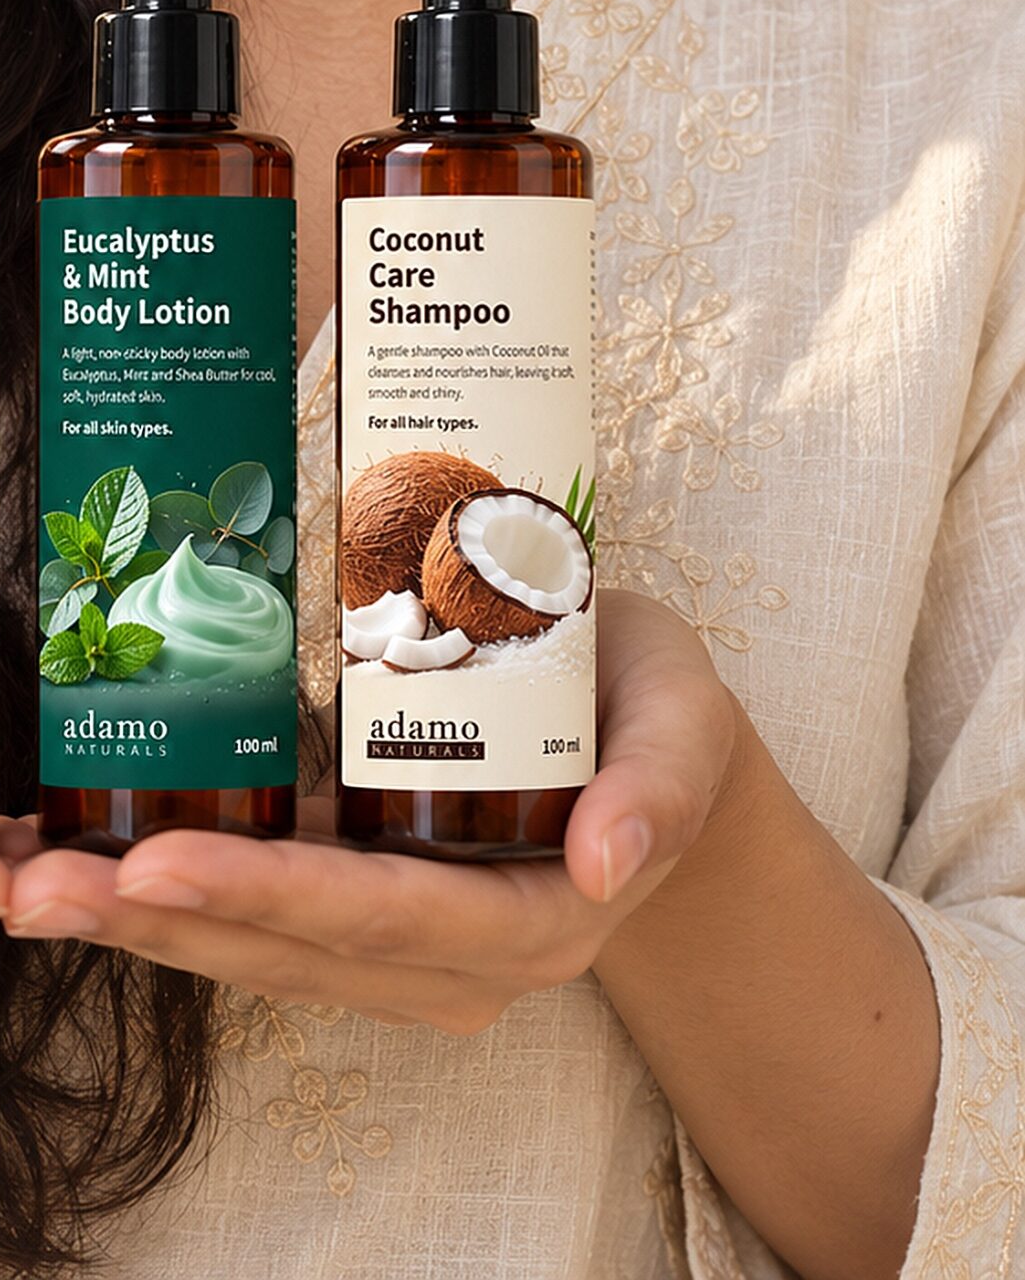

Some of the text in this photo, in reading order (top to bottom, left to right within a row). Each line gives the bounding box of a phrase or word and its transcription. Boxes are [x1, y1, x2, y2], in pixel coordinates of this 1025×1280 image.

[63, 227, 215, 260] Eucalyptus
[369, 227, 485, 252] Coconut
[63, 261, 150, 289] & Mint
[369, 262, 435, 288] Care
[63, 297, 230, 332] Body Lotion
[369, 296, 510, 330] Shampoo
[62, 347, 70, 359] A
[160, 346, 191, 363] body
[193, 346, 226, 359] lotion
[227, 346, 250, 359] with
[367, 346, 375, 357] A
[377, 345, 409, 360] gentle
[411, 345, 463, 359] shampoo
[465, 345, 490, 357] with
[492, 345, 536, 357] Coconut
[537, 344, 550, 357] Oil
[123, 368, 149, 381] Mint
[151, 368, 174, 381] and
[175, 367, 204, 381] Shea
[205, 367, 239, 381] Butter
[240, 367, 254, 380] for
[367, 365, 411, 378] cleanses
[413, 366, 433, 378] and
[435, 365, 488, 378] nourishes
[515, 366, 550, 381] leaving
[85, 390, 137, 407] hydrated
[368, 387, 407, 399] smooth
[409, 386, 430, 399] and
[62, 420, 173, 438] For all skin types.
[368, 415, 479, 432] For all hair types.
[63, 710, 168, 740] adamo
[371, 711, 479, 740] adamo
[65, 744, 167, 757] NATURALS
[234, 736, 278, 754] 100 ml
[371, 744, 479, 757] NATURALS
[542, 739, 565, 754] 100
